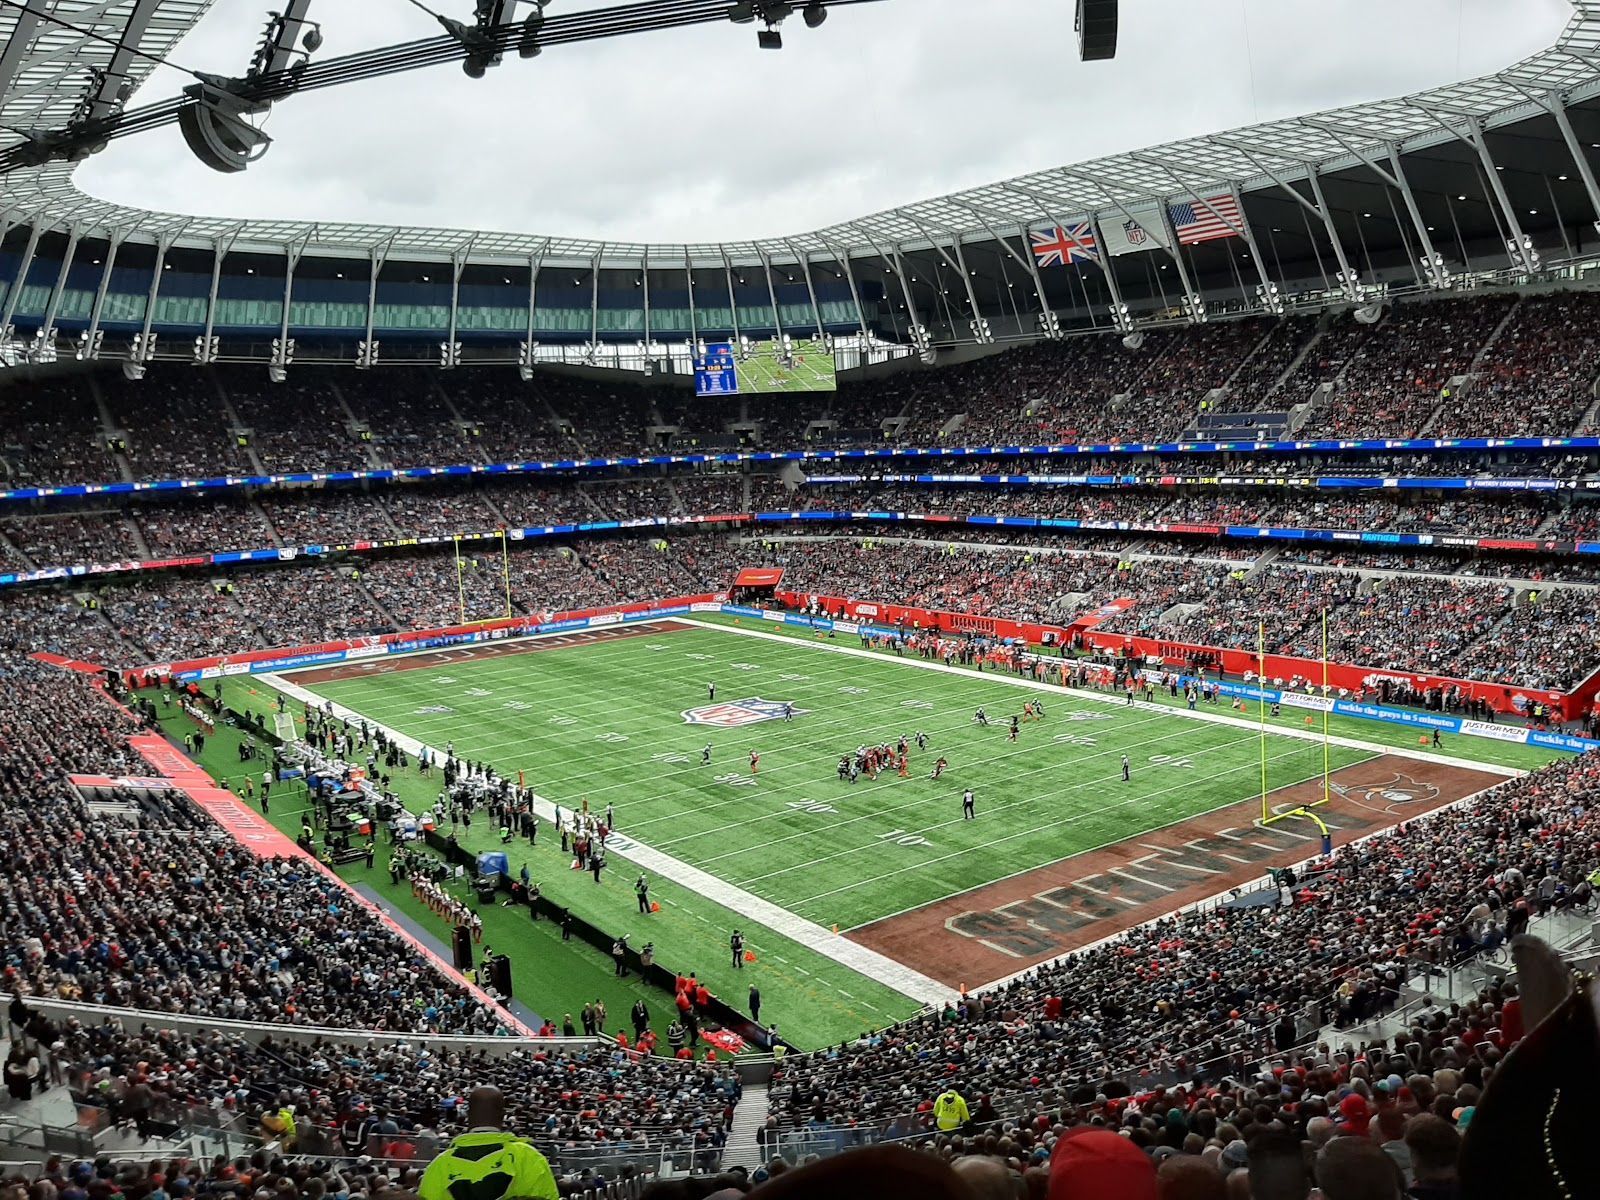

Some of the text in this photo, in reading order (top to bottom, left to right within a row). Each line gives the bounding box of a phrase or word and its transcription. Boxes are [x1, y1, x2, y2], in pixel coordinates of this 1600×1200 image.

[1127, 228, 1146, 243] NFL
[1313, 697, 1332, 705] MEN
[694, 706, 760, 725] NFL
[1338, 703, 1363, 713] tackle
[1364, 706, 1377, 715] the
[1378, 709, 1400, 719] greys
[1401, 711, 1411, 720] in
[1418, 715, 1455, 728] minutes
[1463, 721, 1484, 729] JUST
[1484, 723, 1502, 732] FOR
[1502, 726, 1526, 736] MEN
[1533, 733, 1564, 745] tackle
[1566, 737, 1583, 748] the
[786, 798, 833, 813] 20
[875, 829, 926, 846] 10
